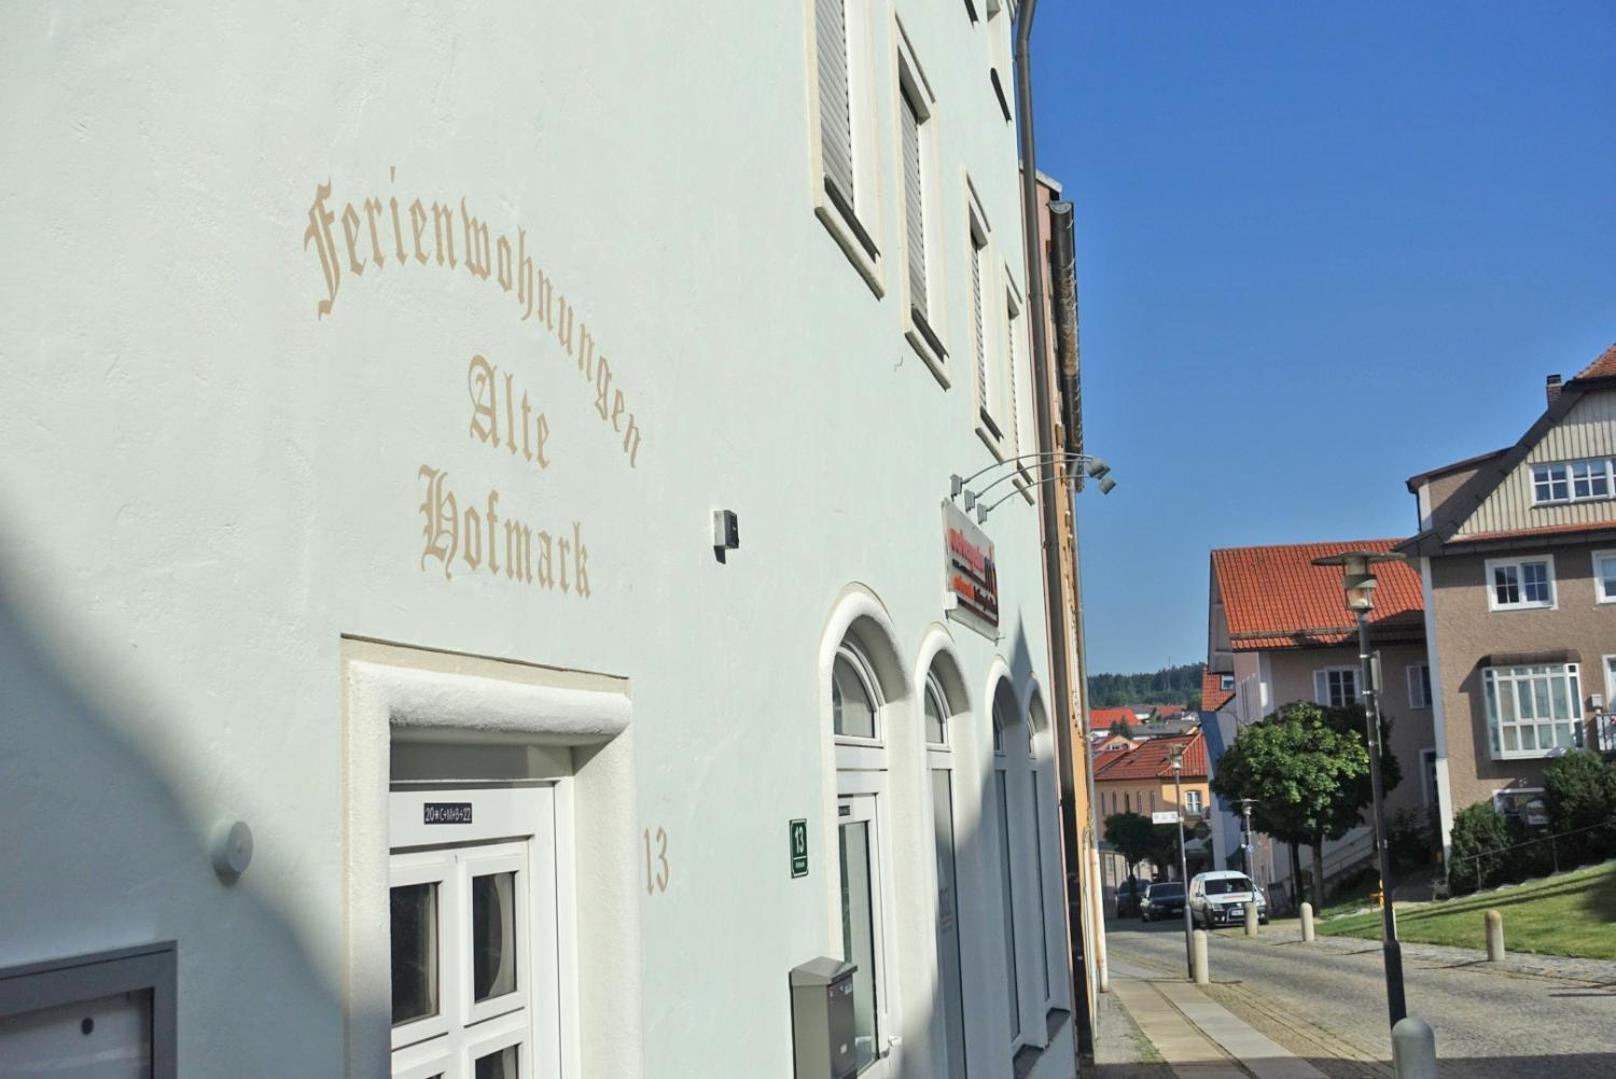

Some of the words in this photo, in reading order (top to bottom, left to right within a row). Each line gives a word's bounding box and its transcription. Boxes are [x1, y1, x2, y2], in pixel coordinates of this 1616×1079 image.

[304, 166, 641, 468] Ferienwohnungen
[468, 354, 550, 470] Alte
[418, 463, 591, 599] Hofmark
[644, 826, 670, 896] 13
[794, 826, 805, 854] 13
